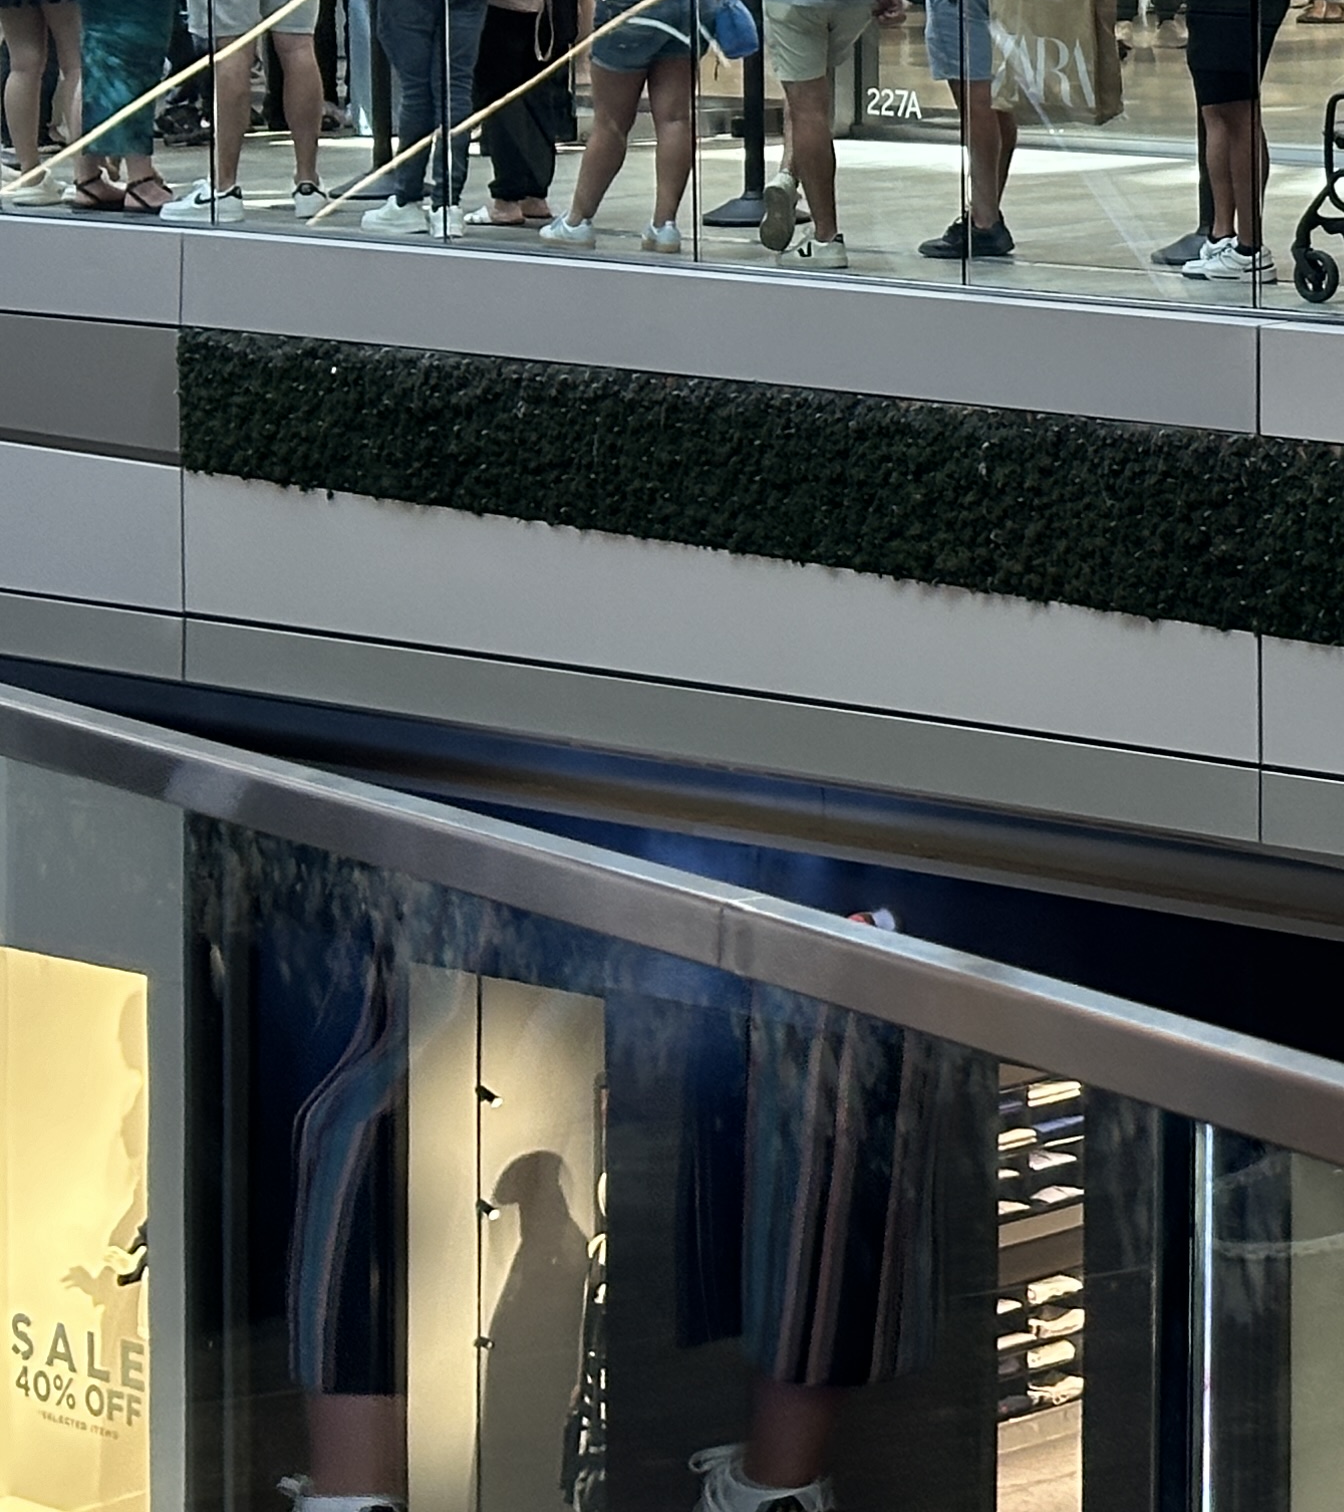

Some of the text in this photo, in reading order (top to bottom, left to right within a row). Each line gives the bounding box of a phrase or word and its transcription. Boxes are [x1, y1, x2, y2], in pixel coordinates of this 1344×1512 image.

[867, 87, 922, 119] 227A
[990, 34, 1096, 108] ZARA
[12, 1313, 145, 1392] SALE
[15, 1365, 142, 1427] 40% OFF
